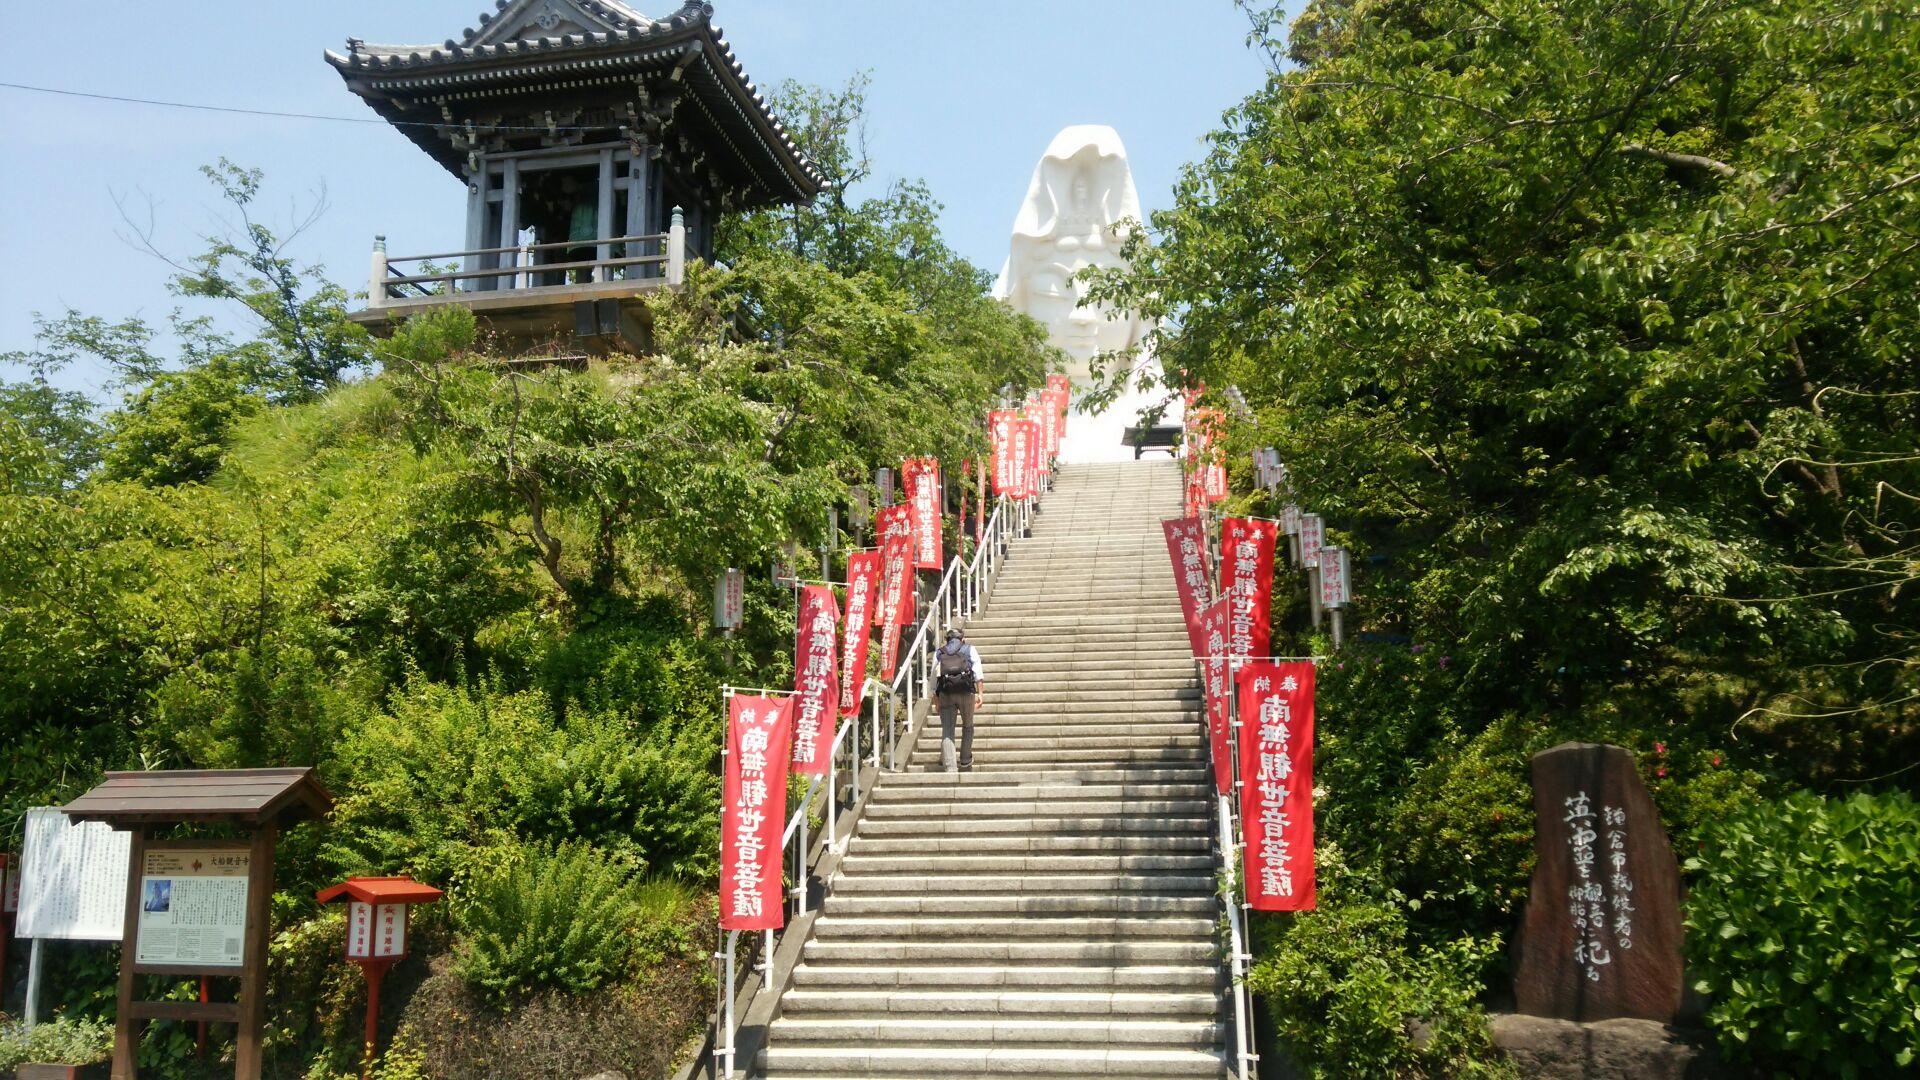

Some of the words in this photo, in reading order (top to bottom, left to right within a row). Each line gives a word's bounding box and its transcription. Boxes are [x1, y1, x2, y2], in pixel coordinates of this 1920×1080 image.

[916, 475, 936, 562] 南無観世音菩薩
